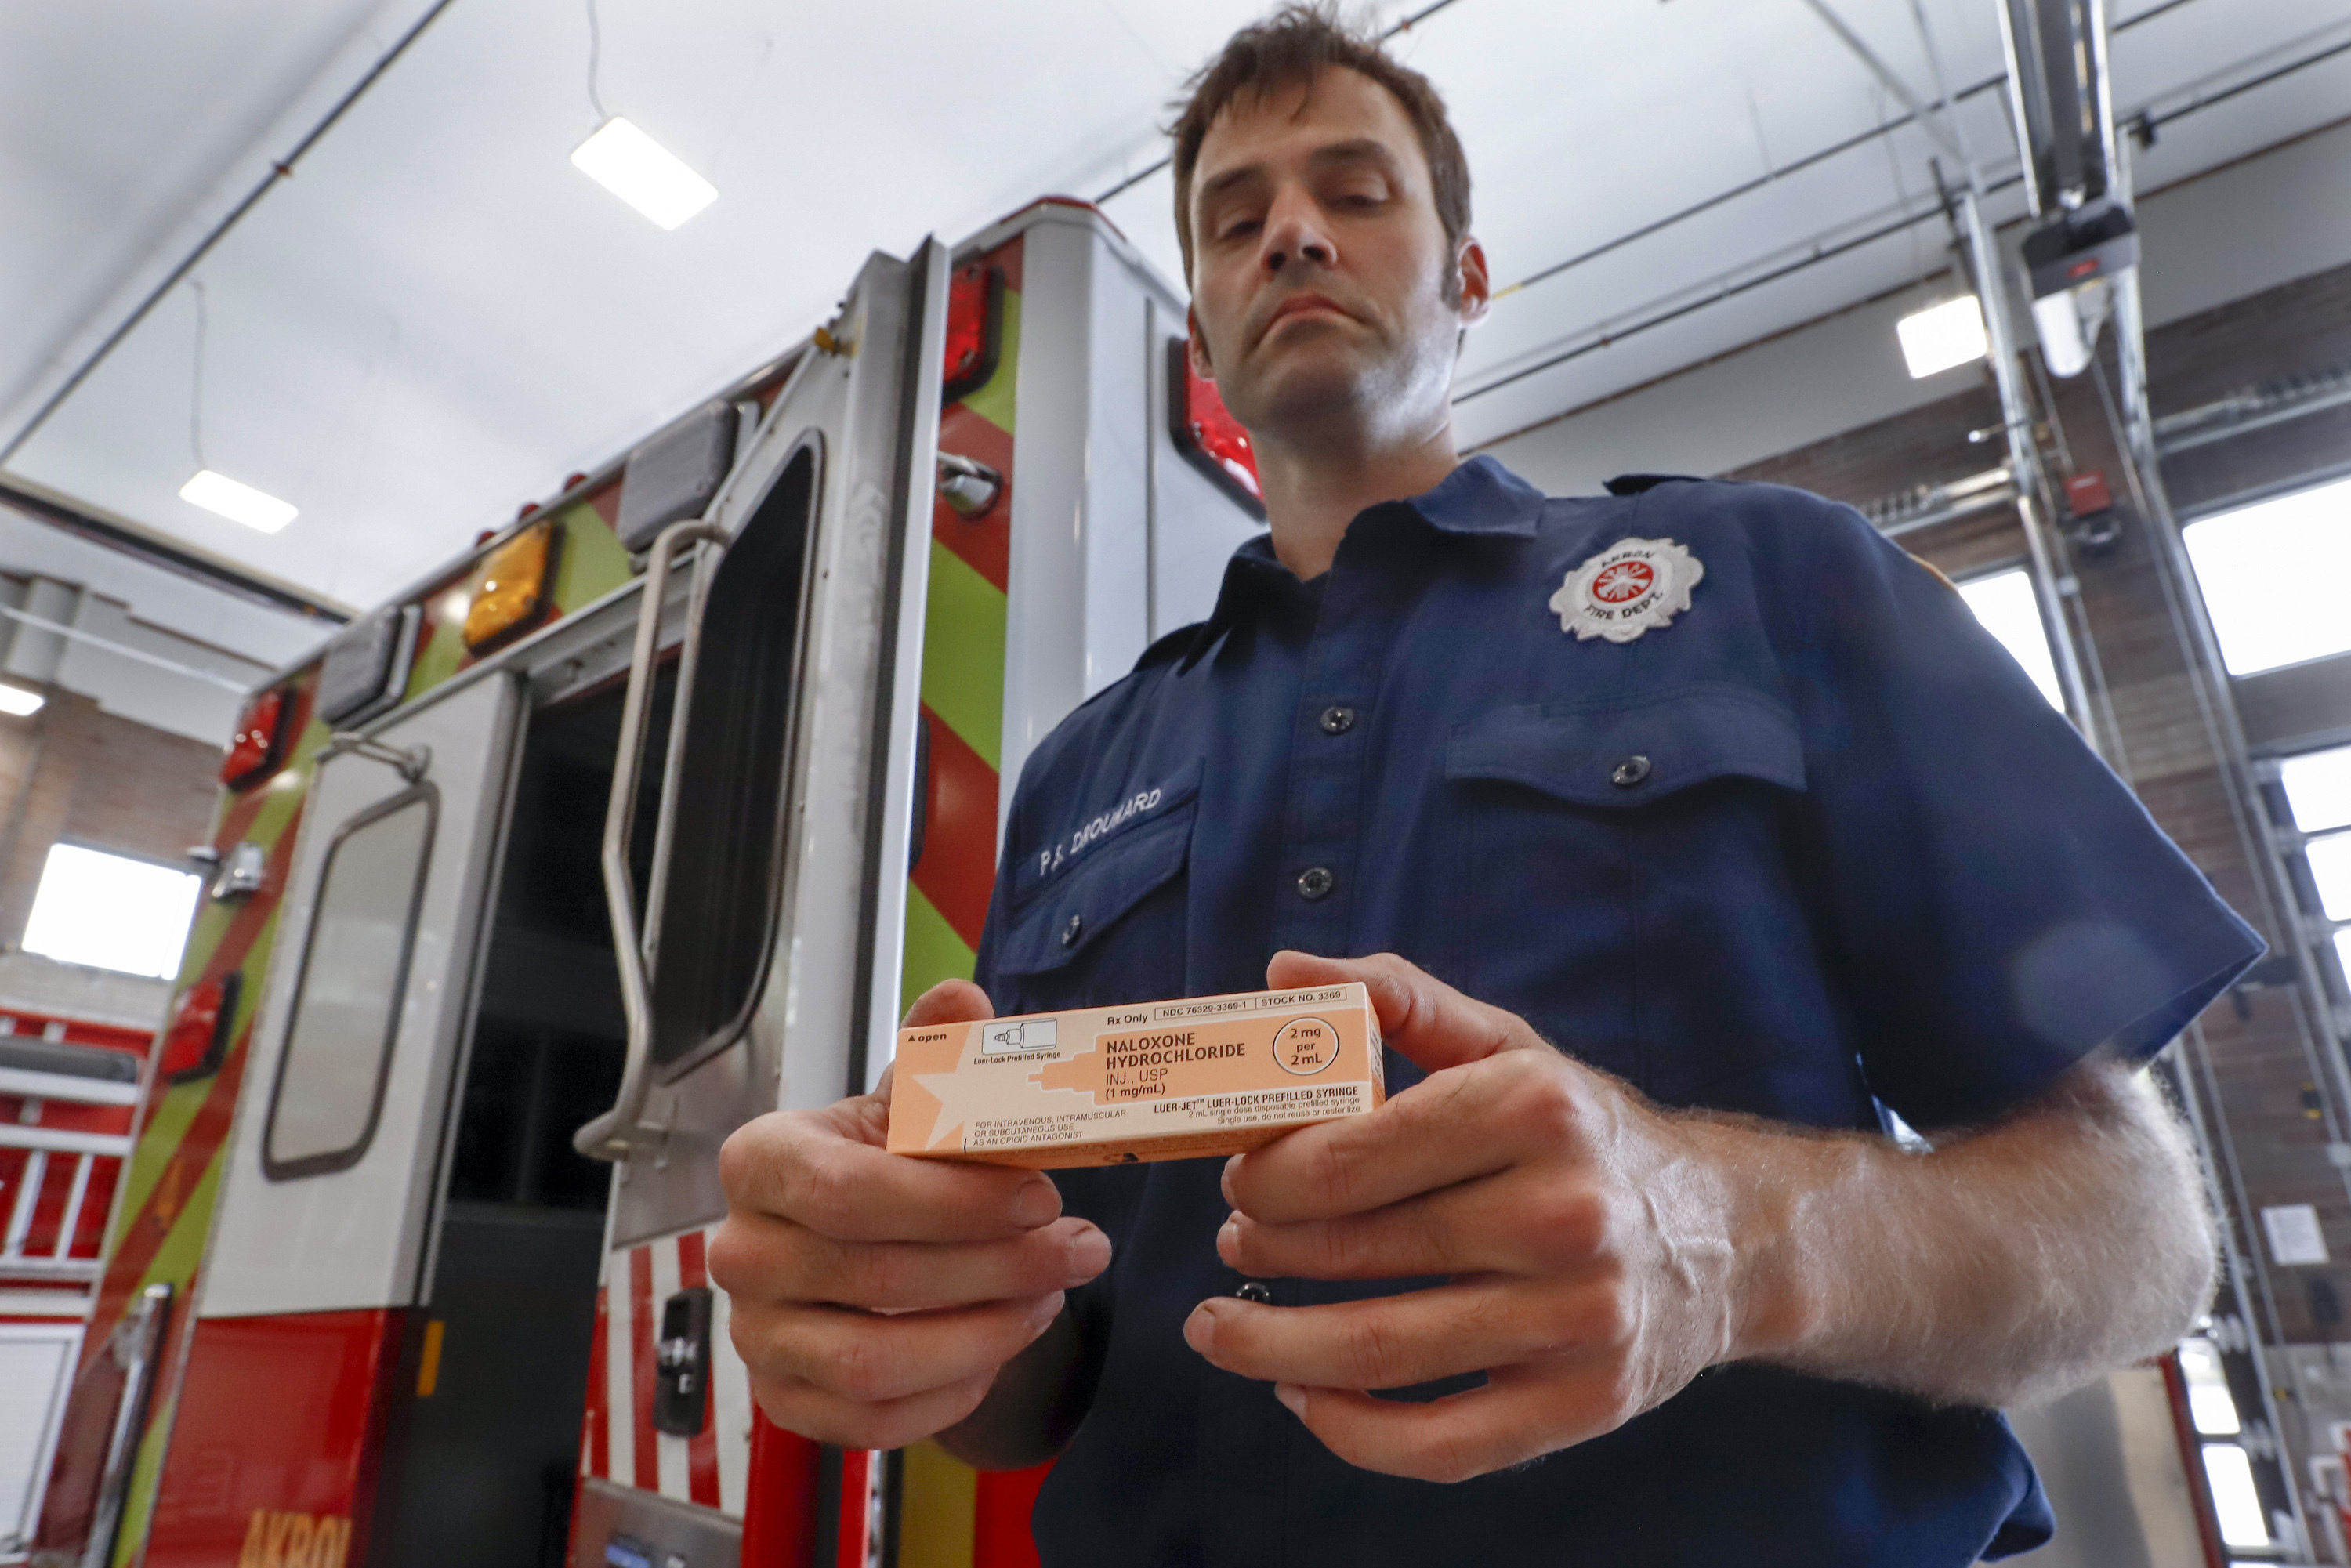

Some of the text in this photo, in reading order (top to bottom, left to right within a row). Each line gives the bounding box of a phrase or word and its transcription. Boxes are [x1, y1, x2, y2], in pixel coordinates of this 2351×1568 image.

[1583, 603, 1614, 620] FIRE
[1107, 990, 1341, 1026] Rx Only NDC 76329-3369-1 STOCK NO. 3369
[918, 1033, 947, 1043] open
[1290, 1028, 1321, 1039] 2 mg
[1107, 1032, 1195, 1054] NALOXONE
[1296, 1043, 1316, 1053] per
[973, 1052, 1061, 1065] Luer-Lock Prefilled Syringe
[1106, 1043, 1246, 1070] HYDROCHLORIDE
[1291, 1053, 1323, 1066] 2 mL
[1106, 1068, 1168, 1086] INJ., USP
[1106, 1083, 1165, 1100] (1 mg/mL)
[1207, 1095, 1259, 1109] LUER-LOCK
[1262, 1090, 1313, 1103] PREFILLED
[1317, 1086, 1358, 1098] SYRINGE
[1209, 1107, 1232, 1116] single
[1255, 1103, 1296, 1112] disposable
[1298, 1099, 1329, 1110] prefilled
[1331, 1097, 1360, 1106] syringe
[975, 1110, 1127, 1129] FOR INTRAVENOUS, INTRAMUSCULAR
[1218, 1117, 1241, 1125] Single
[988, 1124, 1056, 1136] SUBCUTANEOUS
[1057, 1123, 1074, 1132] USE
[973, 1131, 1084, 1146] AS AN OPIOID ANTAGONIST
